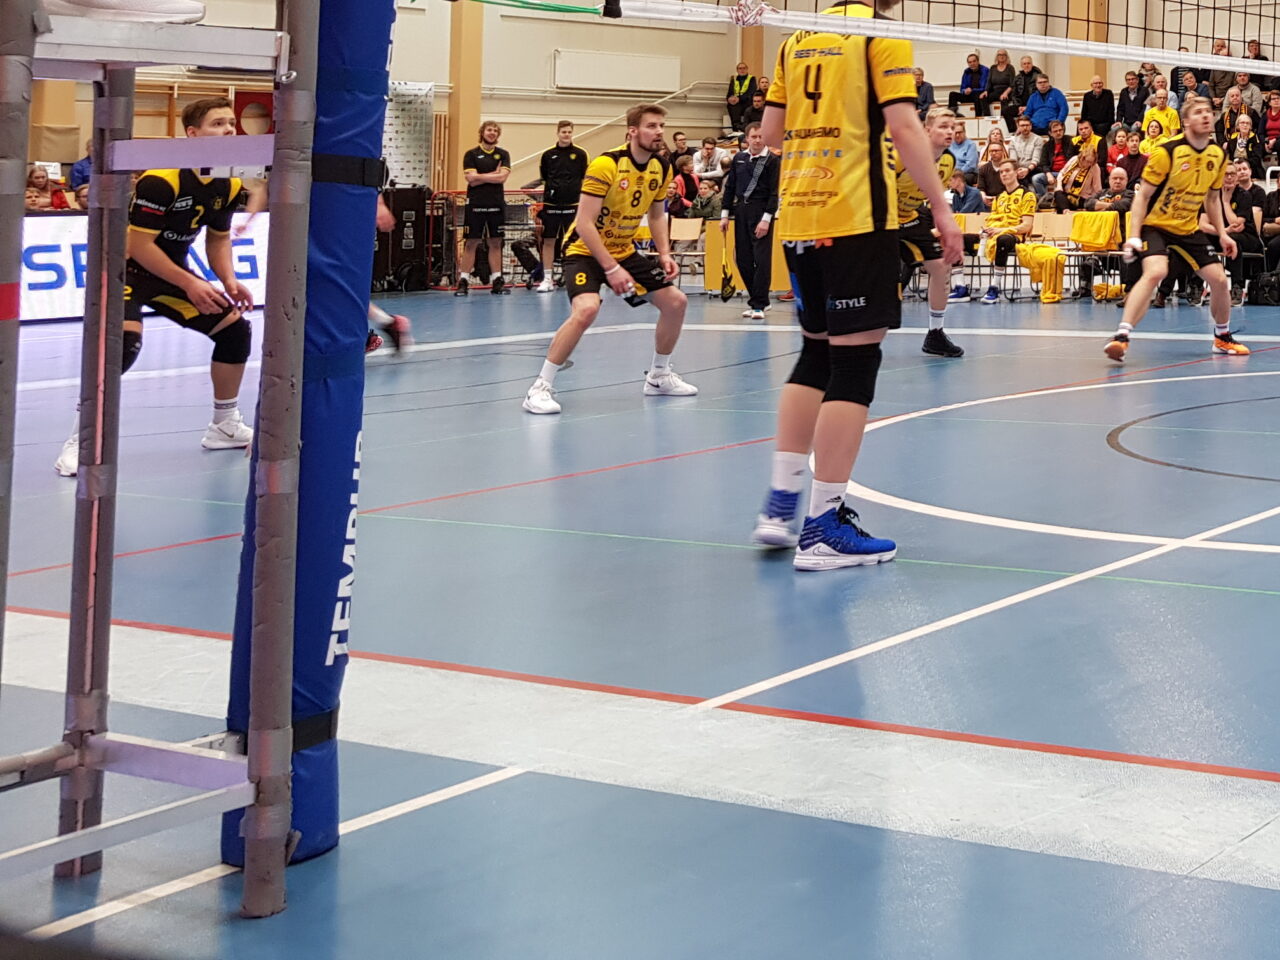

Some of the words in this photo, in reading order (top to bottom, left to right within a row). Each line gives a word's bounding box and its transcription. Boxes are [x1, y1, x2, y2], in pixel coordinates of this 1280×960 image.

[804, 63, 822, 115] 4
[631, 190, 642, 207] 8
[190, 205, 205, 229] 2
[575, 272, 587, 285] 8
